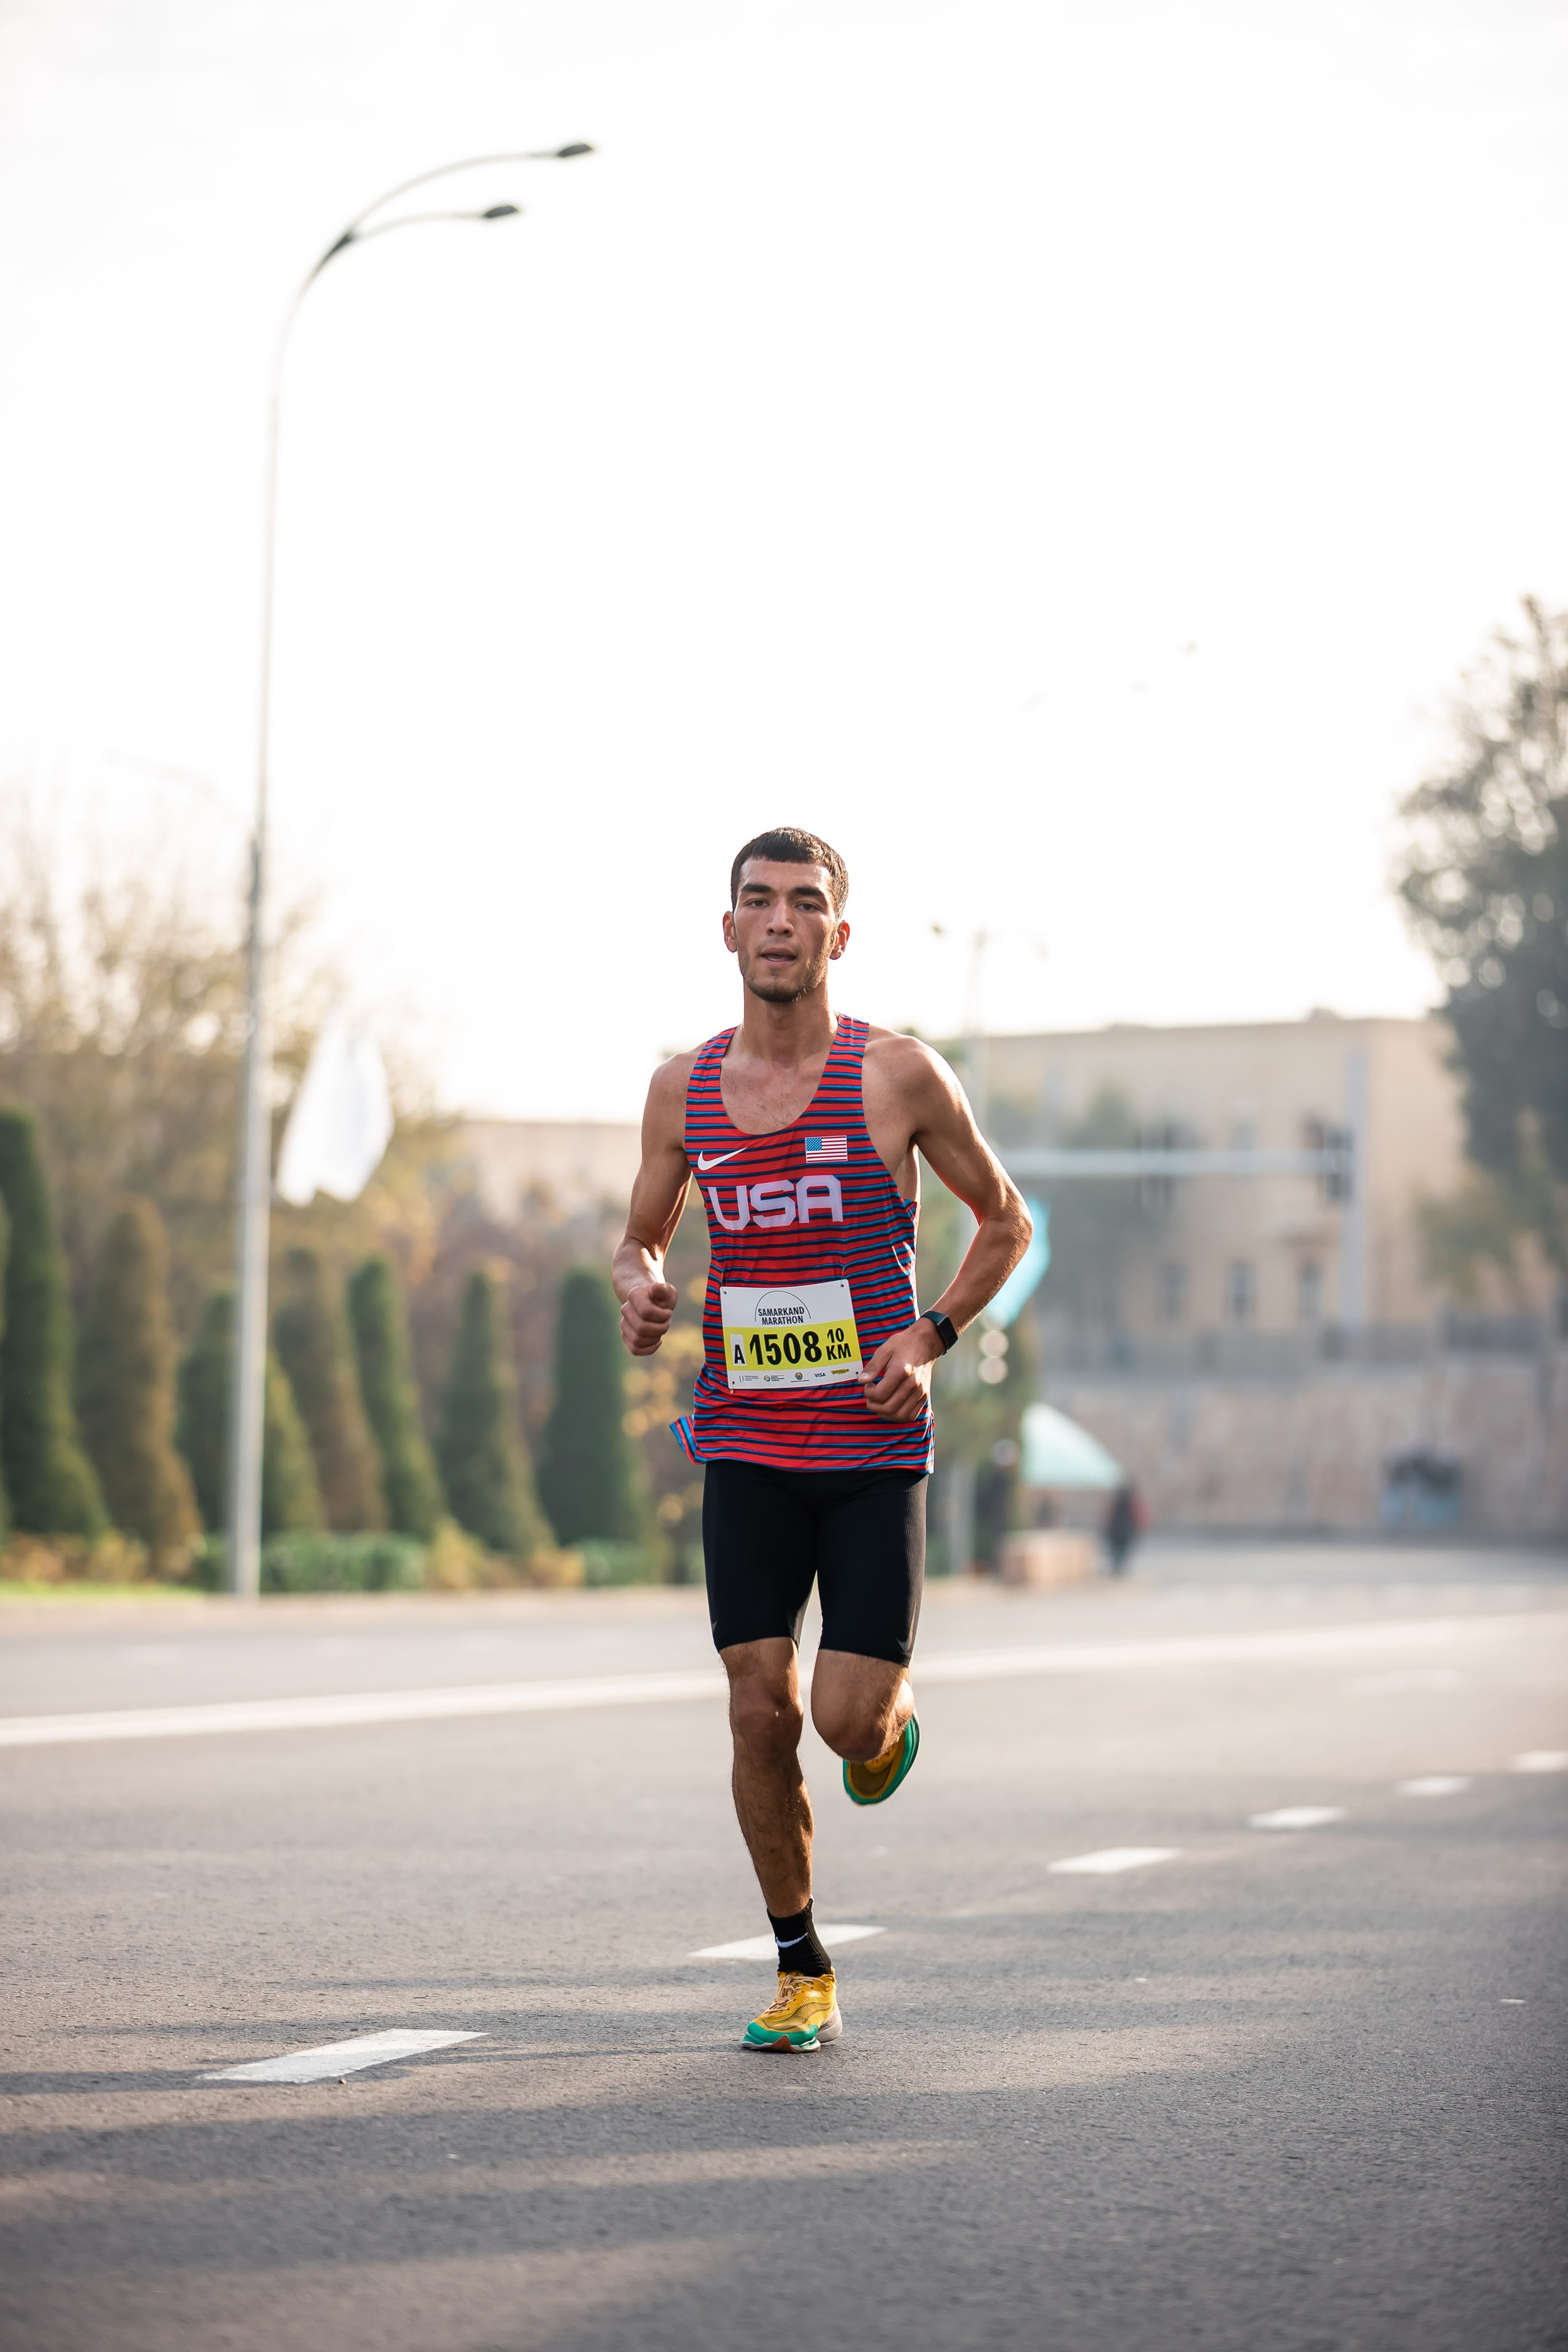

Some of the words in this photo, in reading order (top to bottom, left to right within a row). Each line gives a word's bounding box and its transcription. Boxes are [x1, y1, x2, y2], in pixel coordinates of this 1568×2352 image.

[707, 1175, 843, 1231] USA
[758, 1306, 805, 1317] SAMARKAND
[761, 1316, 804, 1325] MARATHON
[827, 1327, 845, 1343] 10
[734, 1344, 745, 1365] A
[749, 1331, 822, 1366] 1508
[826, 1343, 852, 1361] KM
